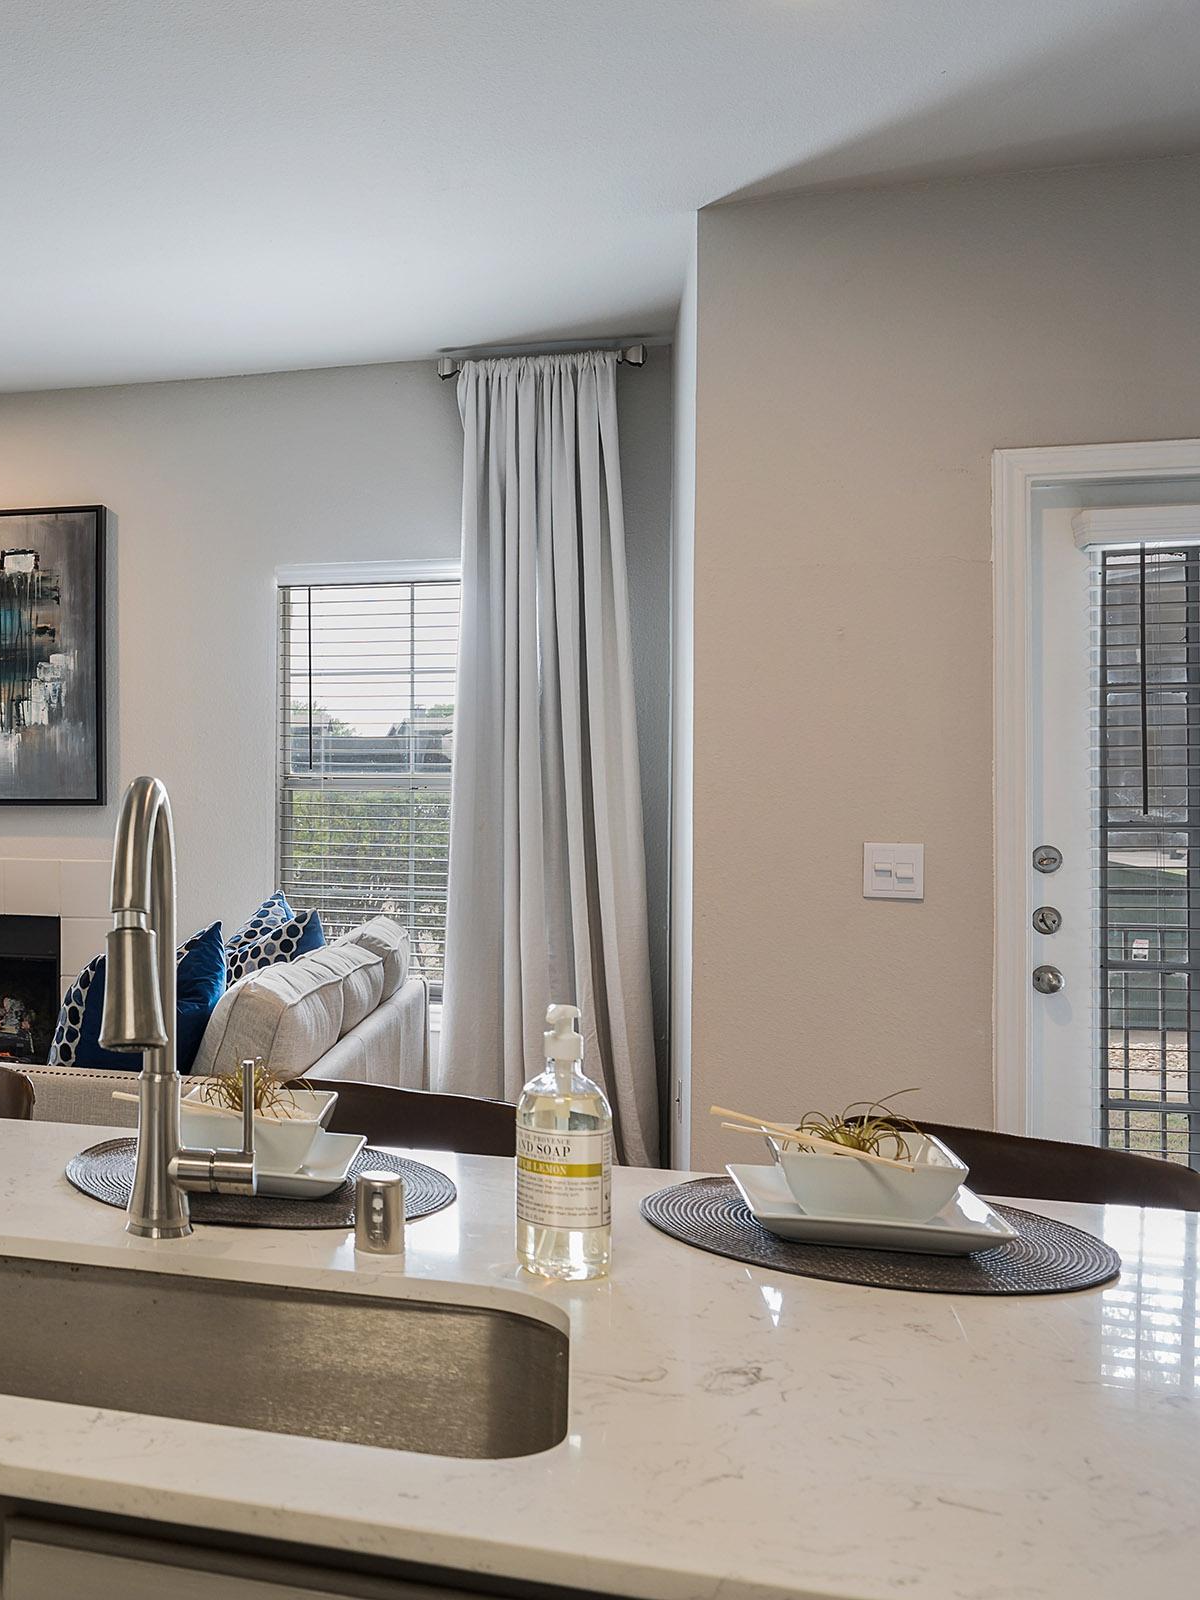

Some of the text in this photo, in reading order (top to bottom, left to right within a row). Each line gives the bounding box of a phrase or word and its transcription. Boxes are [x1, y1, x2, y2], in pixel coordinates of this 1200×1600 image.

[533, 1135, 569, 1145] PROVENCE
[536, 1144, 571, 1158] SOAP
[533, 1162, 567, 1176] LEMON
